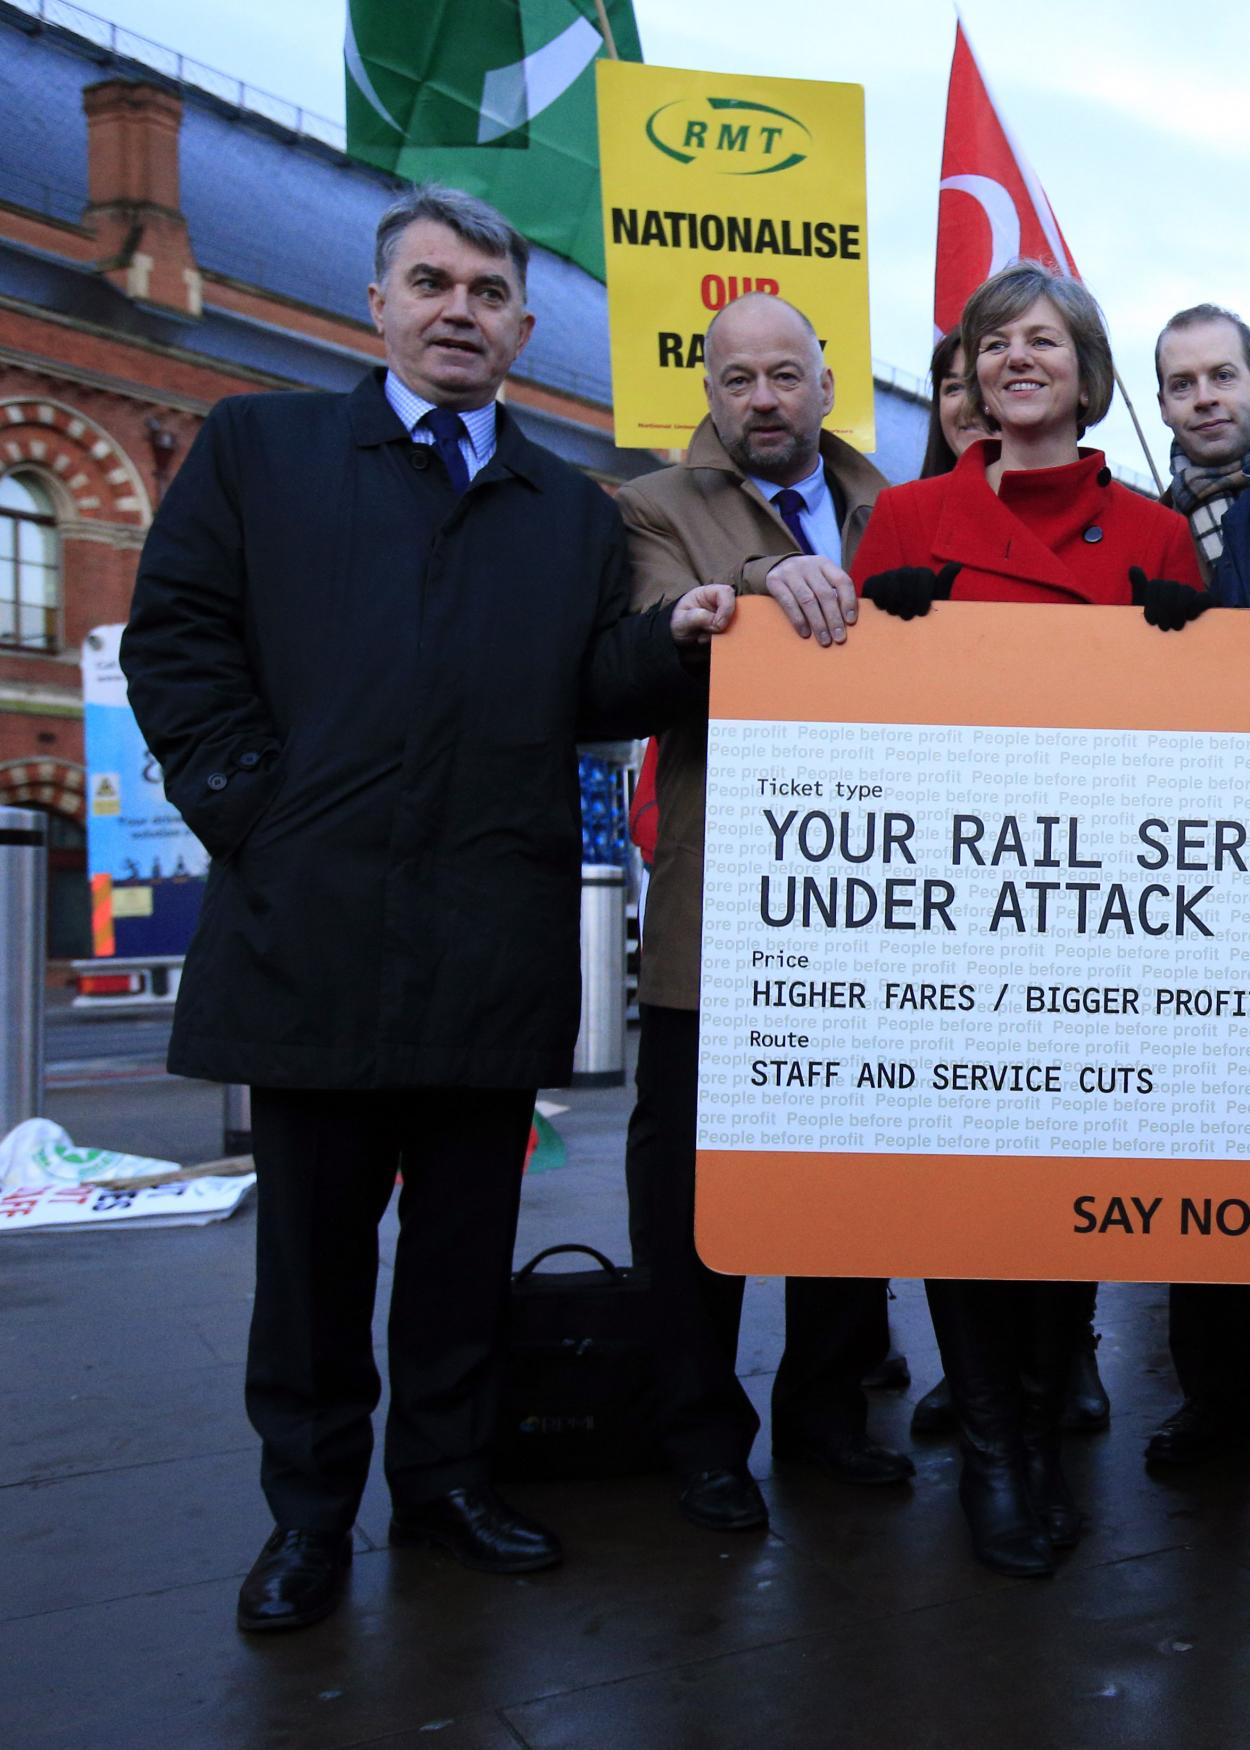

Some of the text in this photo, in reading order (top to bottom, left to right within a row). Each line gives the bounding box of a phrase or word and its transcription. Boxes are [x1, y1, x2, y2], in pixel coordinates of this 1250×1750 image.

[684, 121, 784, 154] RMT
[611, 207, 861, 260] NATIONALISE
[742, 725, 787, 742] profit
[798, 726, 854, 744] People
[860, 728, 912, 742] before
[918, 729, 962, 746] profit
[973, 730, 1029, 748] People
[1034, 732, 1087, 746] before
[1093, 733, 1137, 750] profit
[1147, 734, 1203, 752] People
[710, 744, 766, 761] People
[772, 745, 824, 759] before
[830, 746, 874, 764] profit
[885, 748, 941, 765] People
[947, 749, 999, 763] before
[1005, 750, 1049, 768] profit
[1060, 751, 1116, 769] People
[1121, 753, 1174, 767] before
[1180, 754, 1223, 772] profit
[758, 779, 882, 801] Ticket type
[972, 771, 1028, 789] People
[1033, 772, 1086, 786] before
[1092, 774, 1136, 791] profit
[1146, 775, 1202, 792] People
[1058, 792, 1115, 809] People
[1120, 793, 1173, 807] before
[1179, 794, 1222, 812] profit
[763, 810, 916, 864] YOUR
[953, 815, 1102, 868] RAIL
[761, 876, 1214, 936] UNDER ATTACK
[753, 951, 808, 968] Price
[879, 941, 1219, 965] People before profit People before profit
[753, 981, 865, 1008] HIGHER
[886, 984, 974, 1011] FARES
[994, 984, 1008, 1011] /
[1027, 986, 1139, 1014] BIGGER
[751, 1031, 808, 1047] Route
[964, 1039, 1129, 1059] People before profit
[751, 1061, 1152, 1094] STAFF AND SERVICE CUTS
[699, 1091, 1040, 1115] People before profit People before profit
[787, 1113, 1127, 1136] People before profit People before profit
[698, 1130, 755, 1148] People
[761, 1132, 814, 1146] before
[819, 1133, 864, 1150] profit
[874, 1134, 931, 1151] People
[936, 1135, 989, 1149] before
[995, 1136, 1039, 1154] profit
[1050, 1137, 1106, 1155] People
[1112, 1138, 1164, 1153] before
[1170, 1140, 1214, 1157] profit
[1074, 1196, 1163, 1234] SAY
